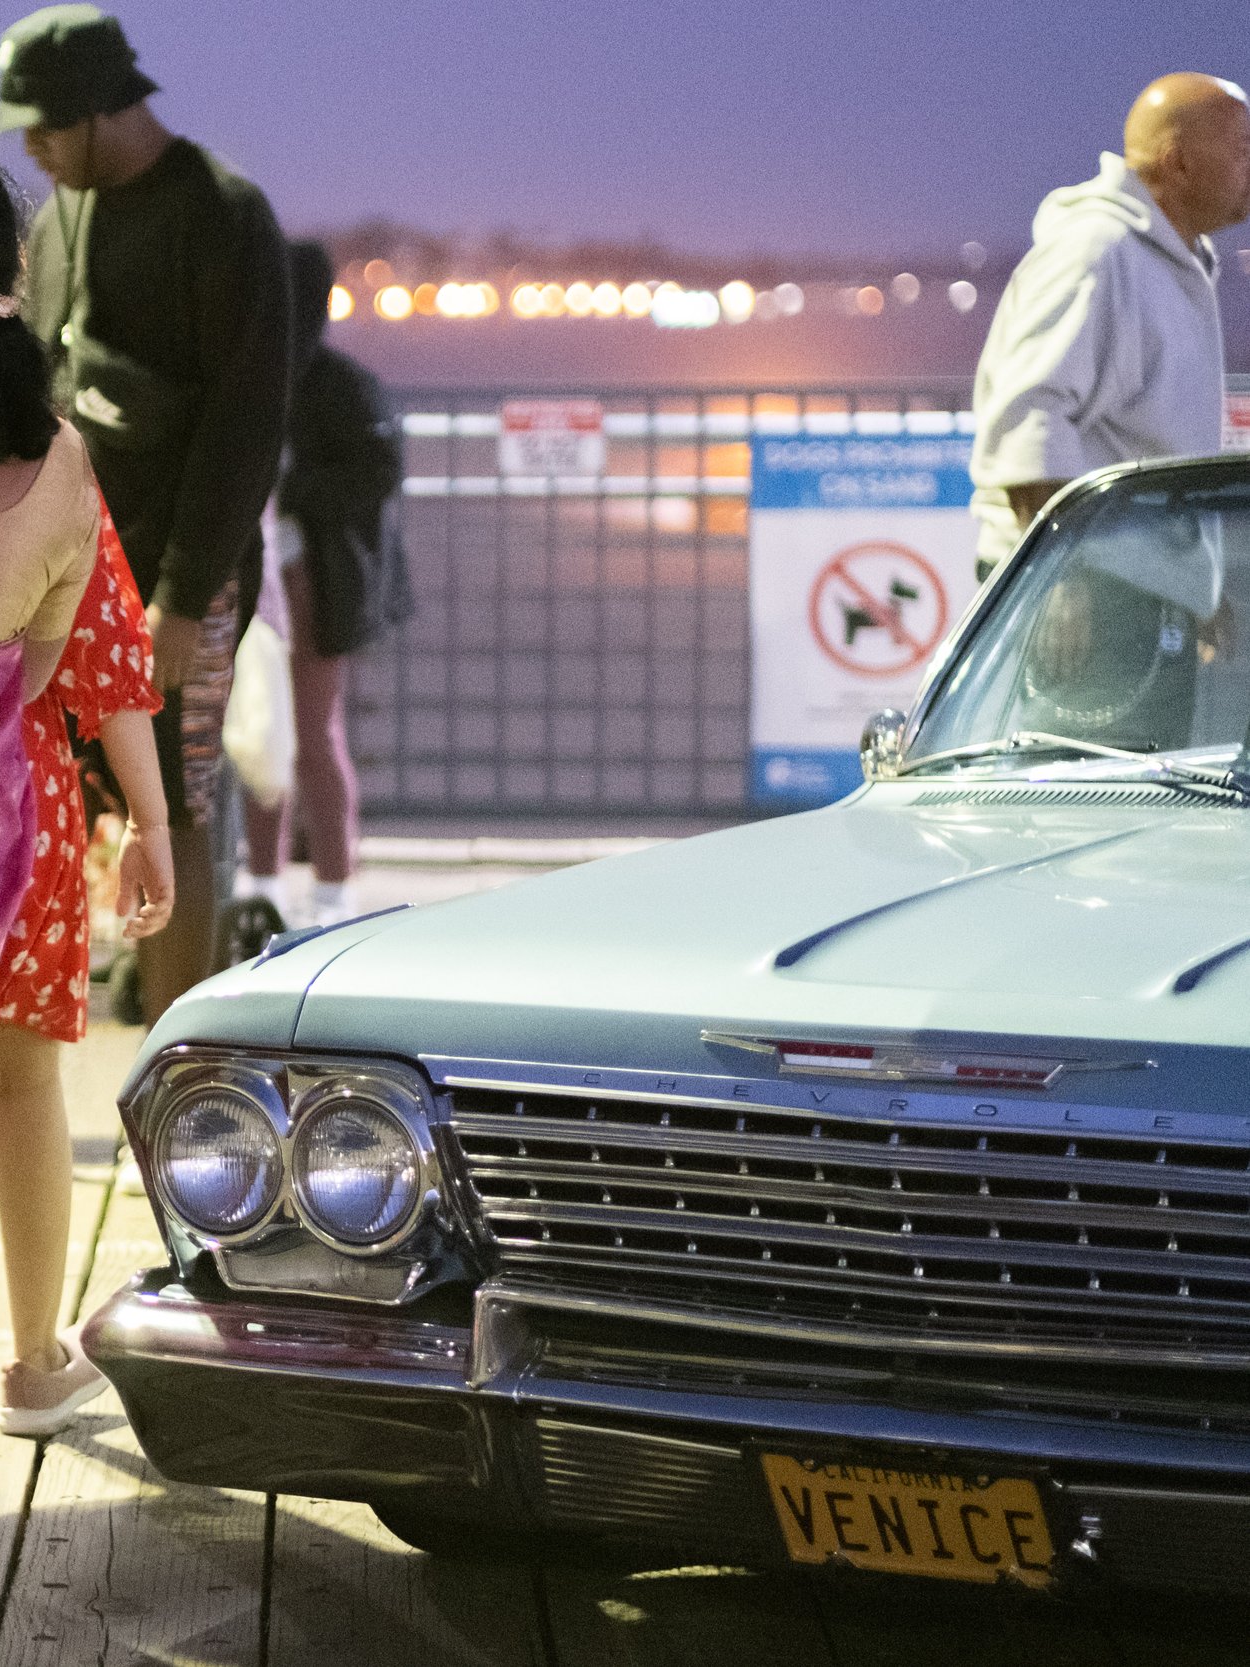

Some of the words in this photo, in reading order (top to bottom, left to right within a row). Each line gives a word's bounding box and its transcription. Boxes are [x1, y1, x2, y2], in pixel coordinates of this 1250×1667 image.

[583, 1072, 1250, 1130] CHEVROLE
[823, 1464, 974, 1493] CALIFORNIA
[780, 1485, 1051, 1572] VENICE
